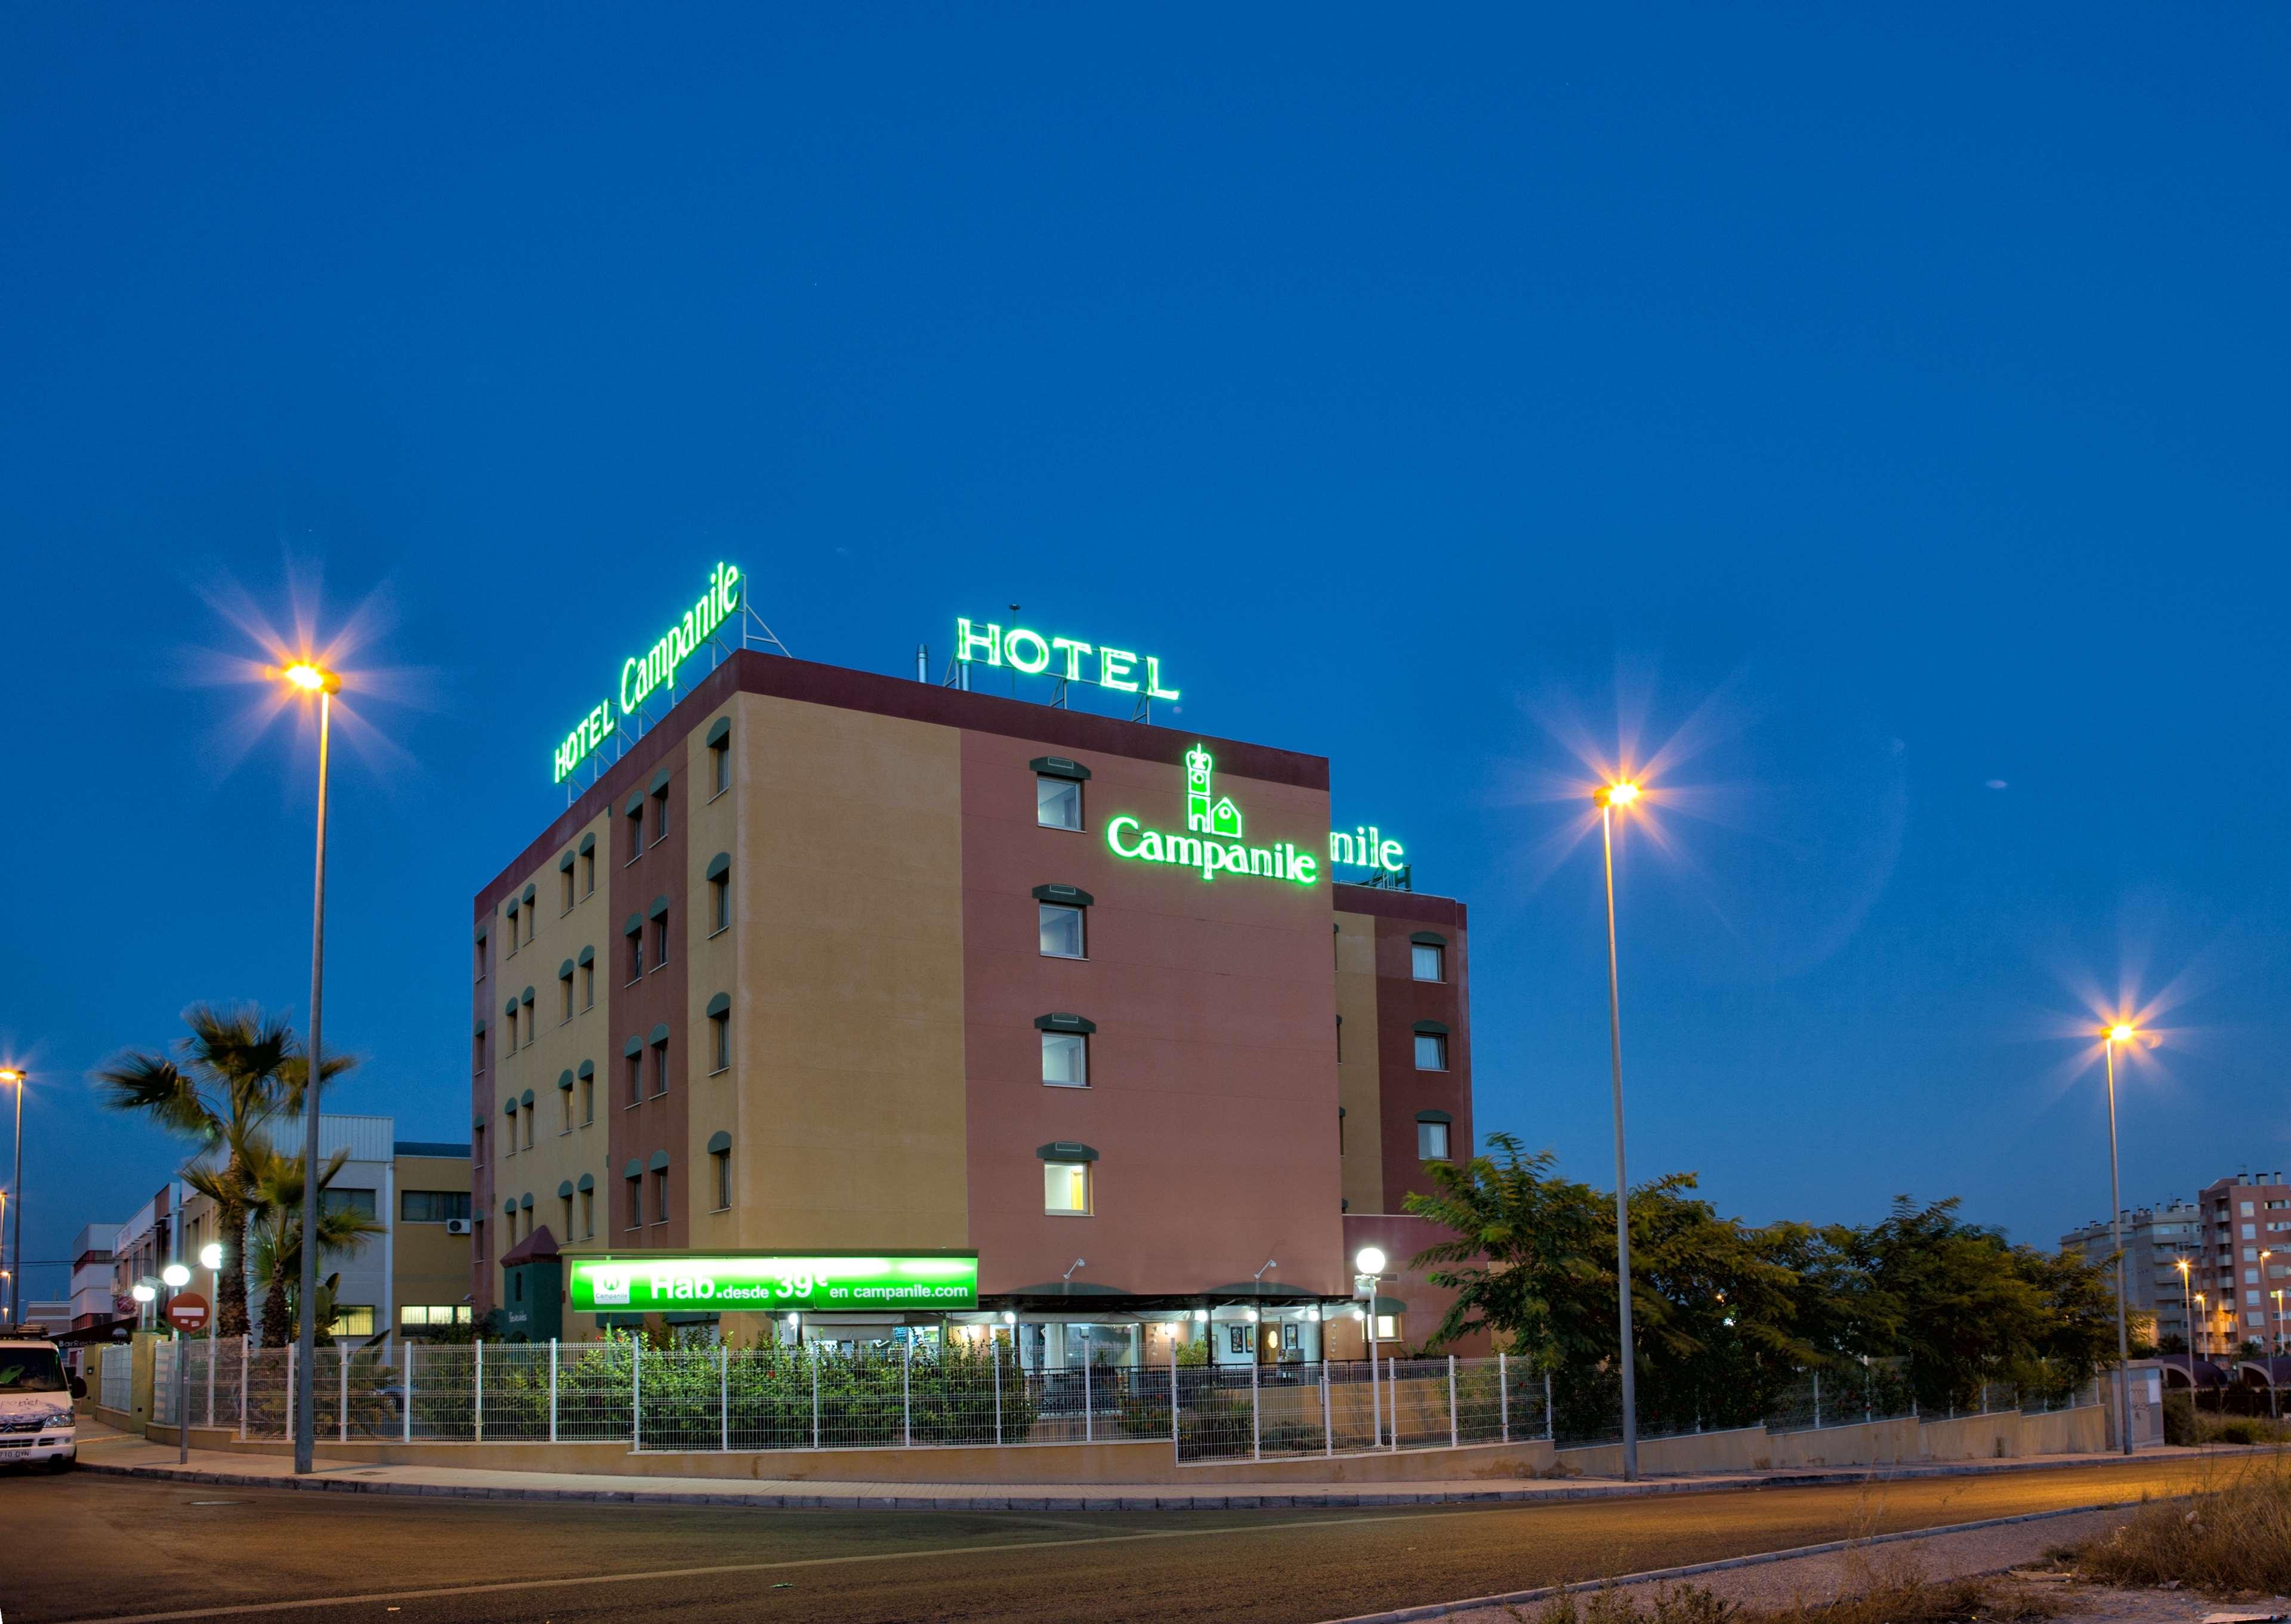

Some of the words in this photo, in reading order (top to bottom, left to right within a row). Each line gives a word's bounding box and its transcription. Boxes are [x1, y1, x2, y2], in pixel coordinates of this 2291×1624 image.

[554, 698, 617, 783] HOTEL
[620, 561, 740, 715] Campanile
[957, 618, 1180, 700] HOTEL
[1107, 816, 1317, 883] Campanile
[723, 1285, 769, 1299] desde
[830, 1288, 848, 1298] en
[853, 1284, 968, 1300] campanile.com
